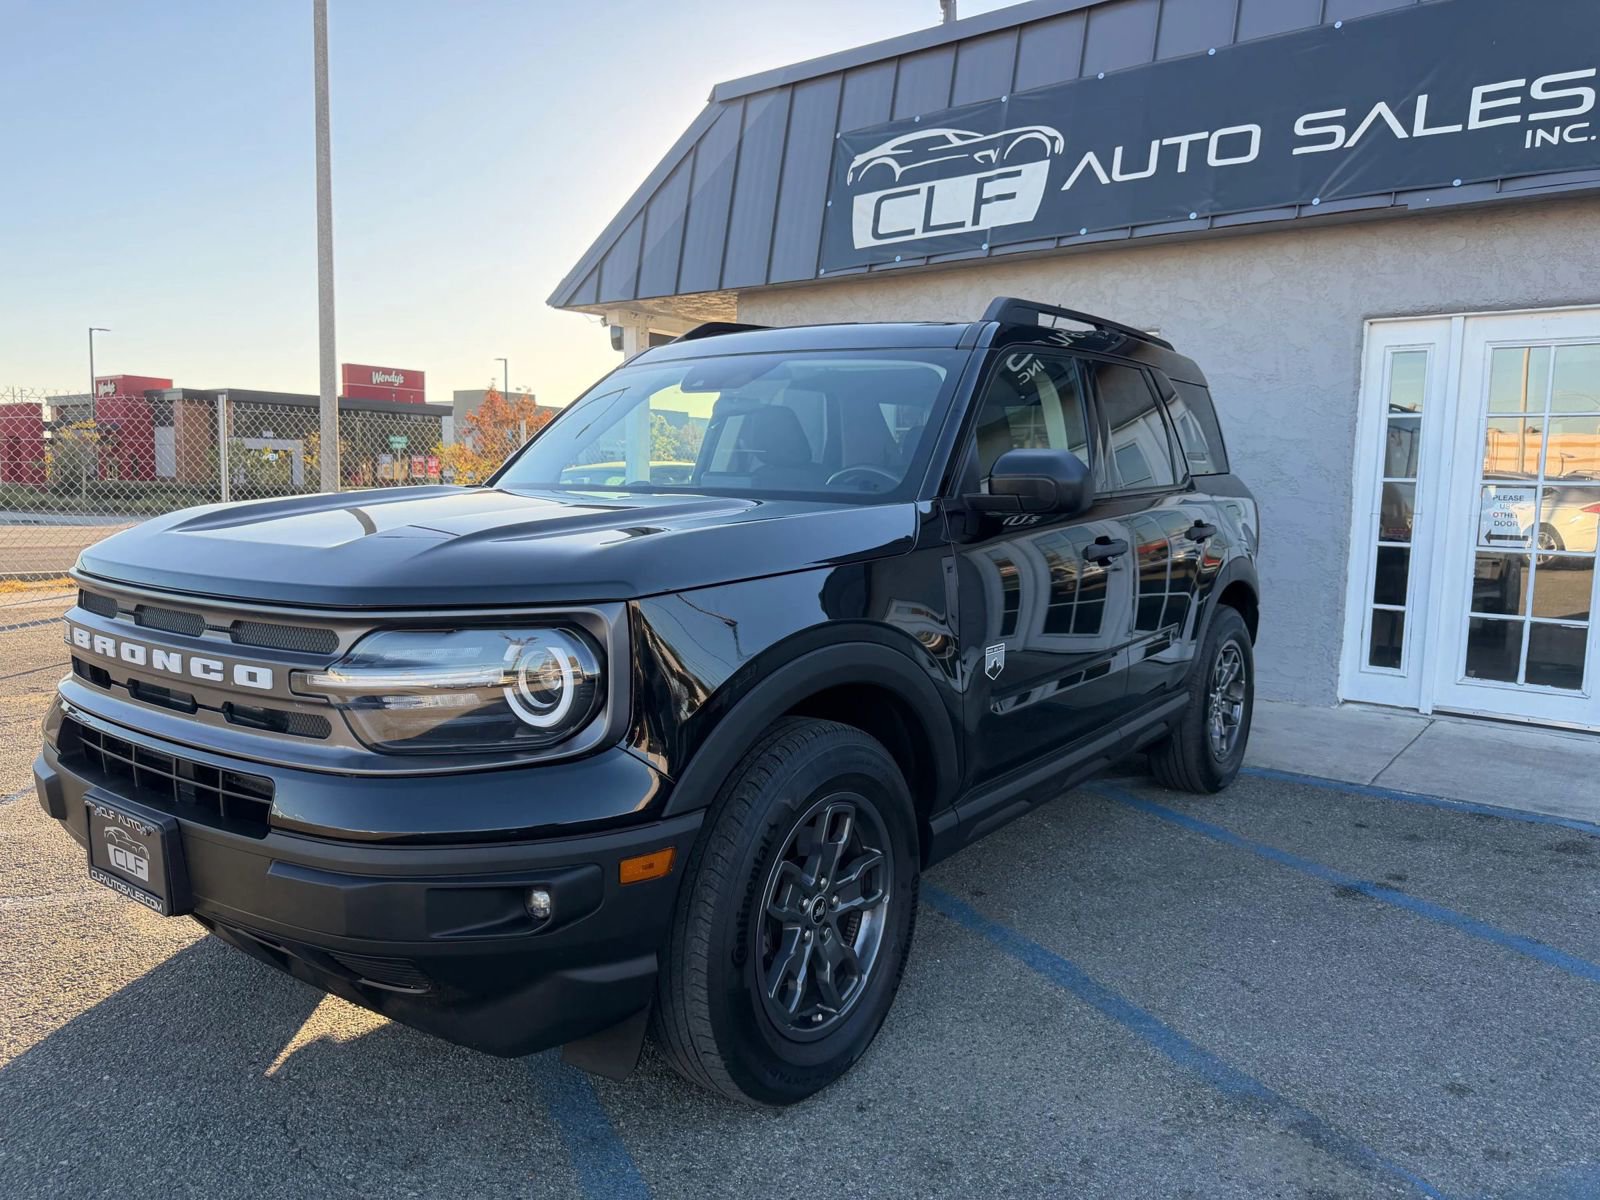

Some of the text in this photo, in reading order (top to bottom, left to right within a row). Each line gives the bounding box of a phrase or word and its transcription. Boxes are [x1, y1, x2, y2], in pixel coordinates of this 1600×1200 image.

[1060, 68, 1596, 191] AUTO SALES
[1524, 122, 1597, 149] INC.
[871, 169, 1022, 240] CLF
[73, 626, 274, 690] BRONCO
[113, 848, 144, 875] CLF
